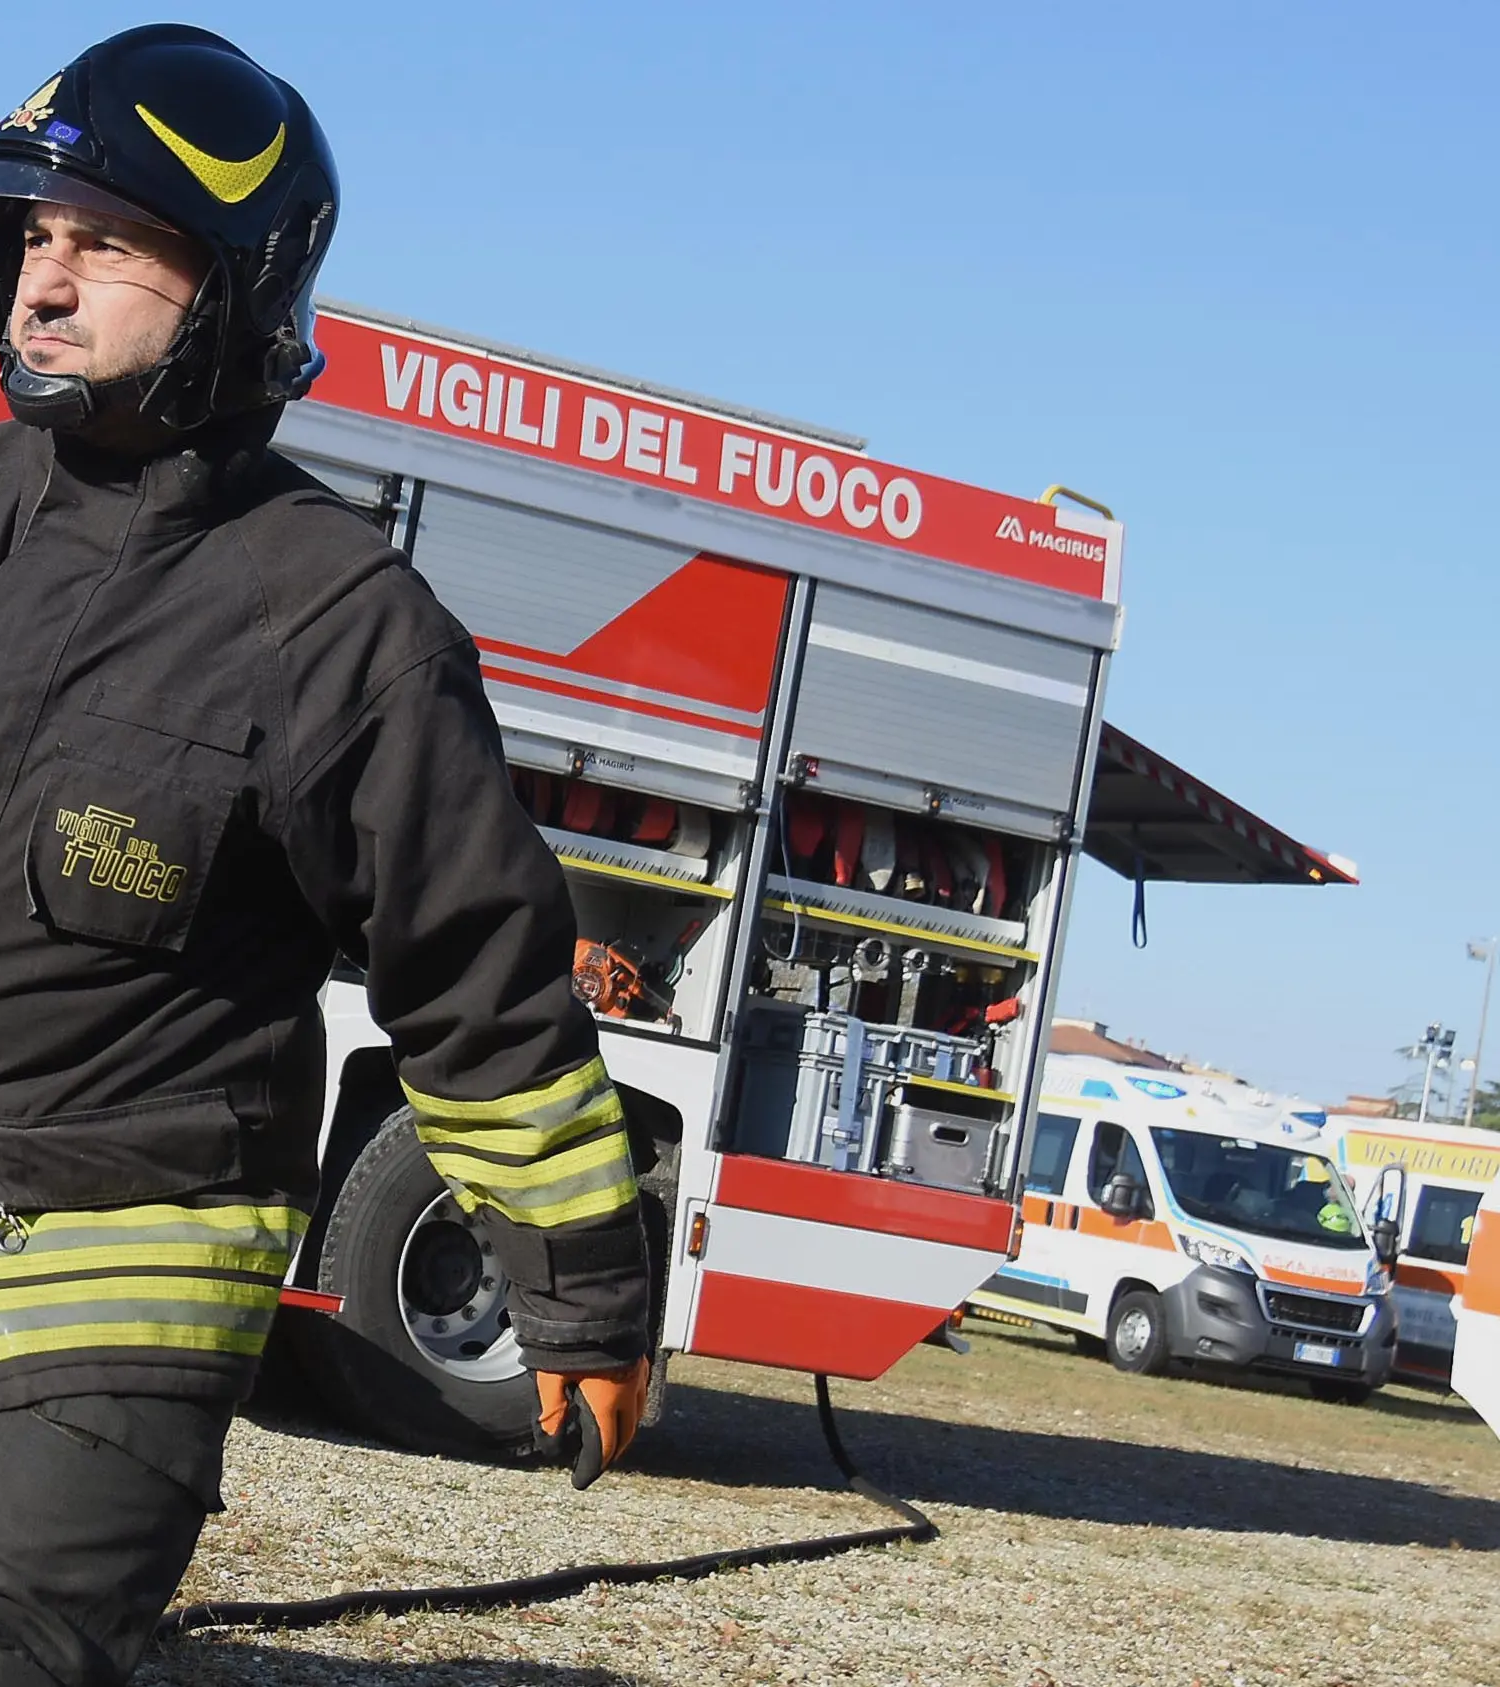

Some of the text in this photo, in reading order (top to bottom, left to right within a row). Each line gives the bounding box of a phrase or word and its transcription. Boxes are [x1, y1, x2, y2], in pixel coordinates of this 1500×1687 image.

[380, 344, 922, 539] VIGILI DEL FUOCO
[1028, 529, 1104, 562] MAGIRUS
[598, 757, 635, 772] MAGIRUS
[55, 808, 158, 861] VIGILI DEL
[62, 805, 187, 902] FUOCO
